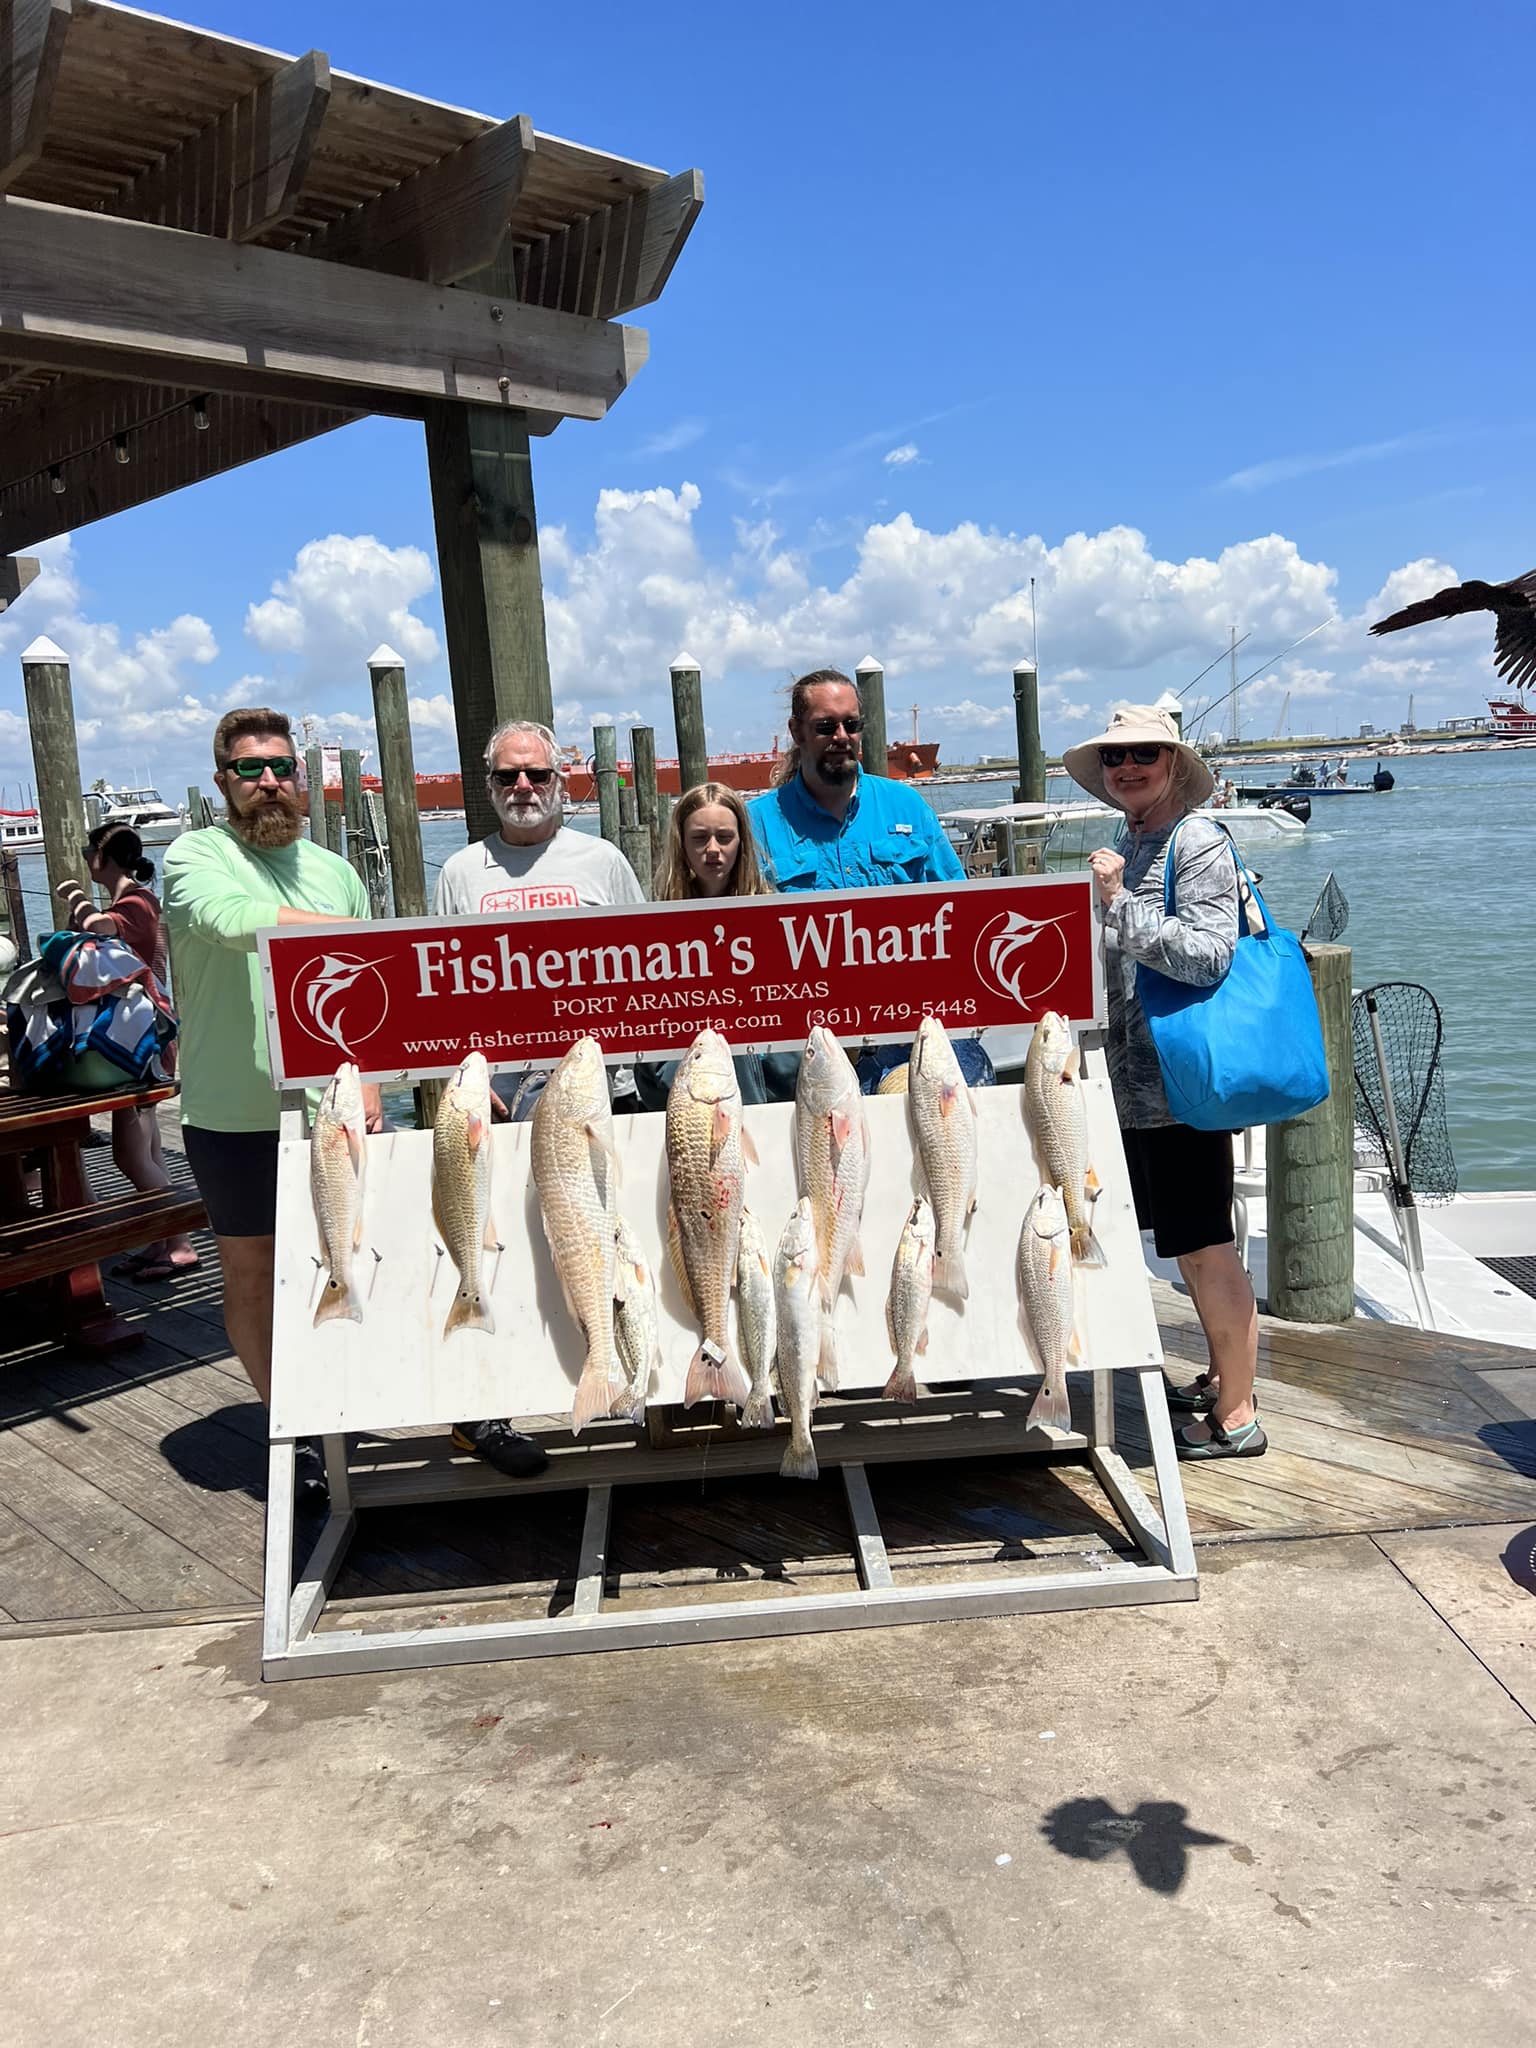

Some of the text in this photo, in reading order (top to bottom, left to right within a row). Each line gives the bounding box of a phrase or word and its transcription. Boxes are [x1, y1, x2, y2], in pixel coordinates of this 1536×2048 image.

[528, 892, 572, 909] FISH
[411, 901, 955, 997] Fisherman's Wharf
[553, 981, 830, 1017] PORT ARANSAS, TEXAS
[402, 998, 977, 1054] www.fishermanswharfporta.com (361) 749-5448
